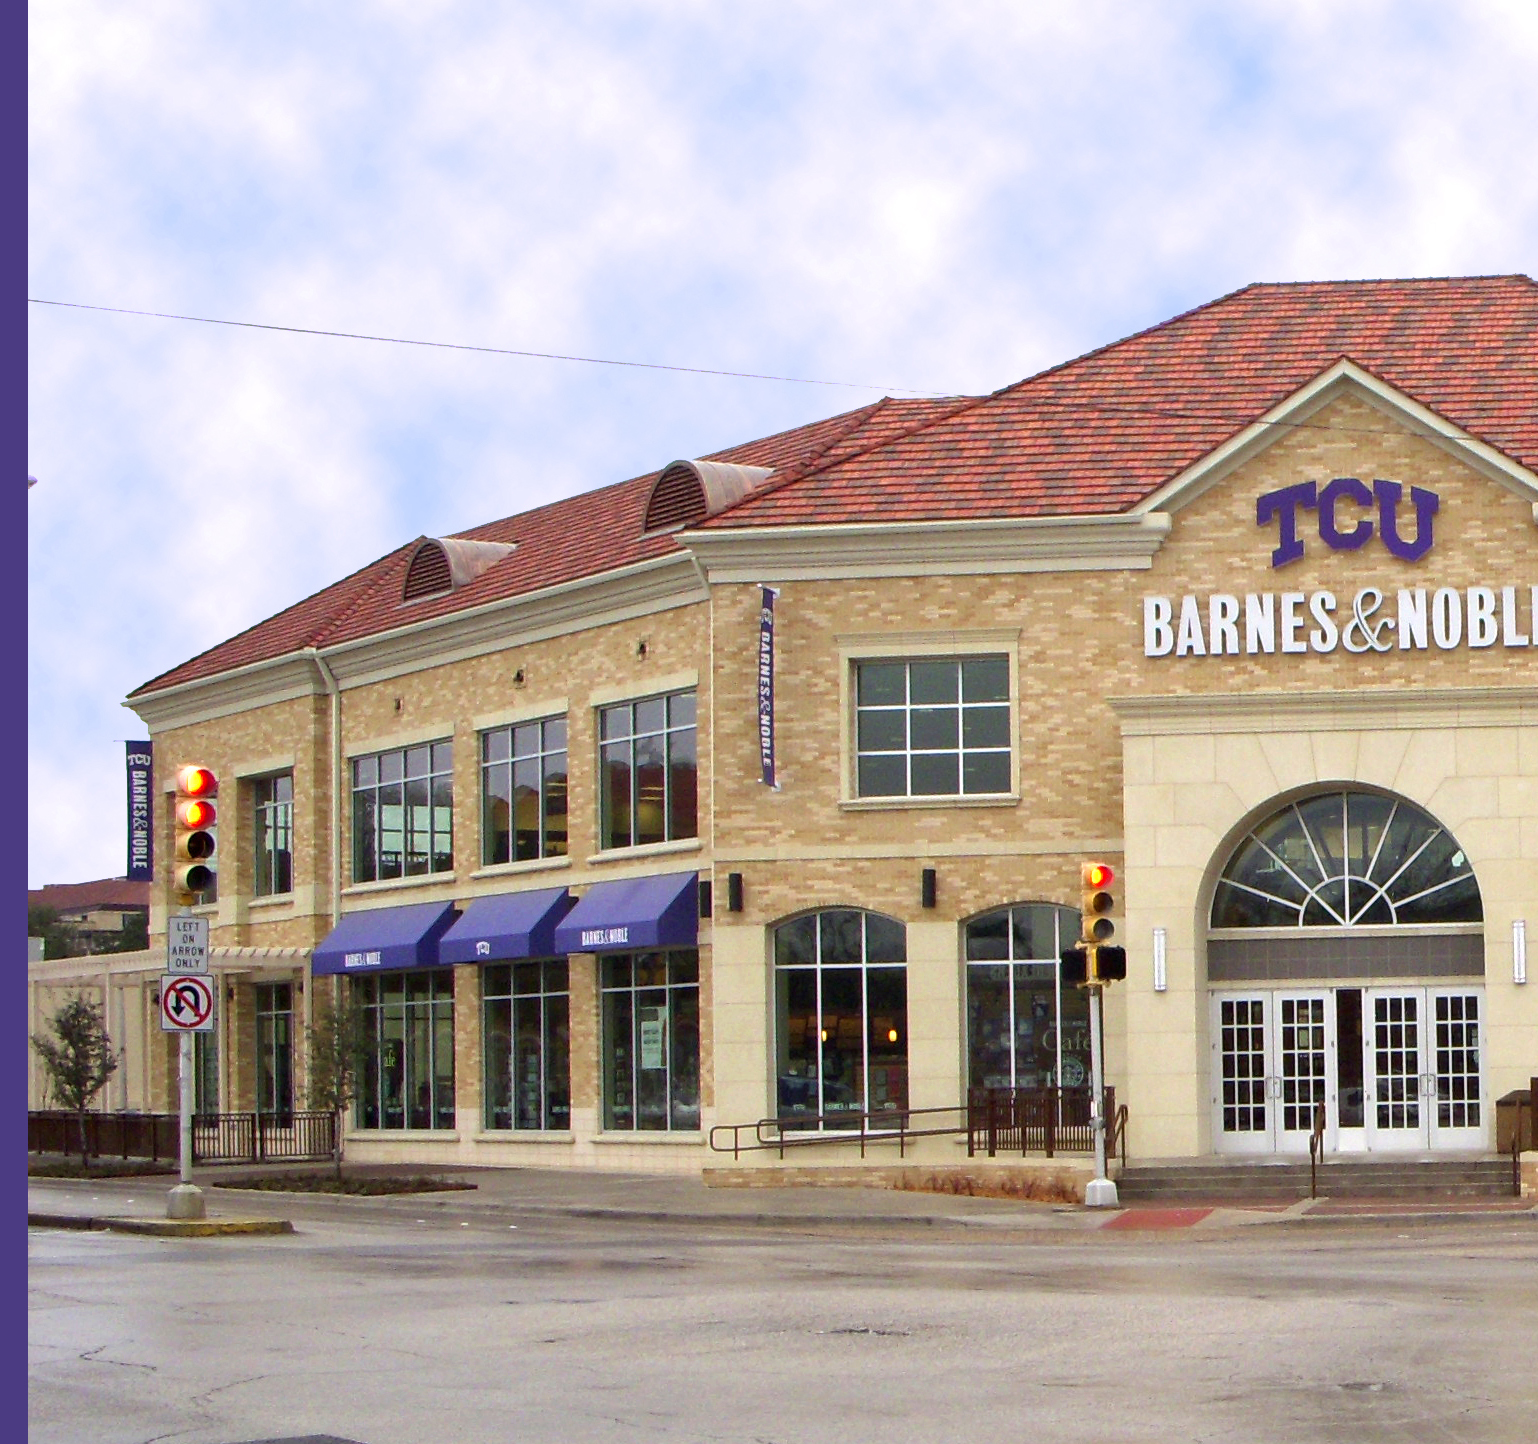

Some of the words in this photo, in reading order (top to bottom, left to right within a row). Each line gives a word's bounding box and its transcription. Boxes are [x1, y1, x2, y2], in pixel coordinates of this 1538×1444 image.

[1256, 478, 1439, 568] TCU
[177, 921, 200, 931] LEFT
[182, 934, 195, 944] ON
[172, 946, 204, 956] ARROW
[175, 958, 200, 968] ONLY
